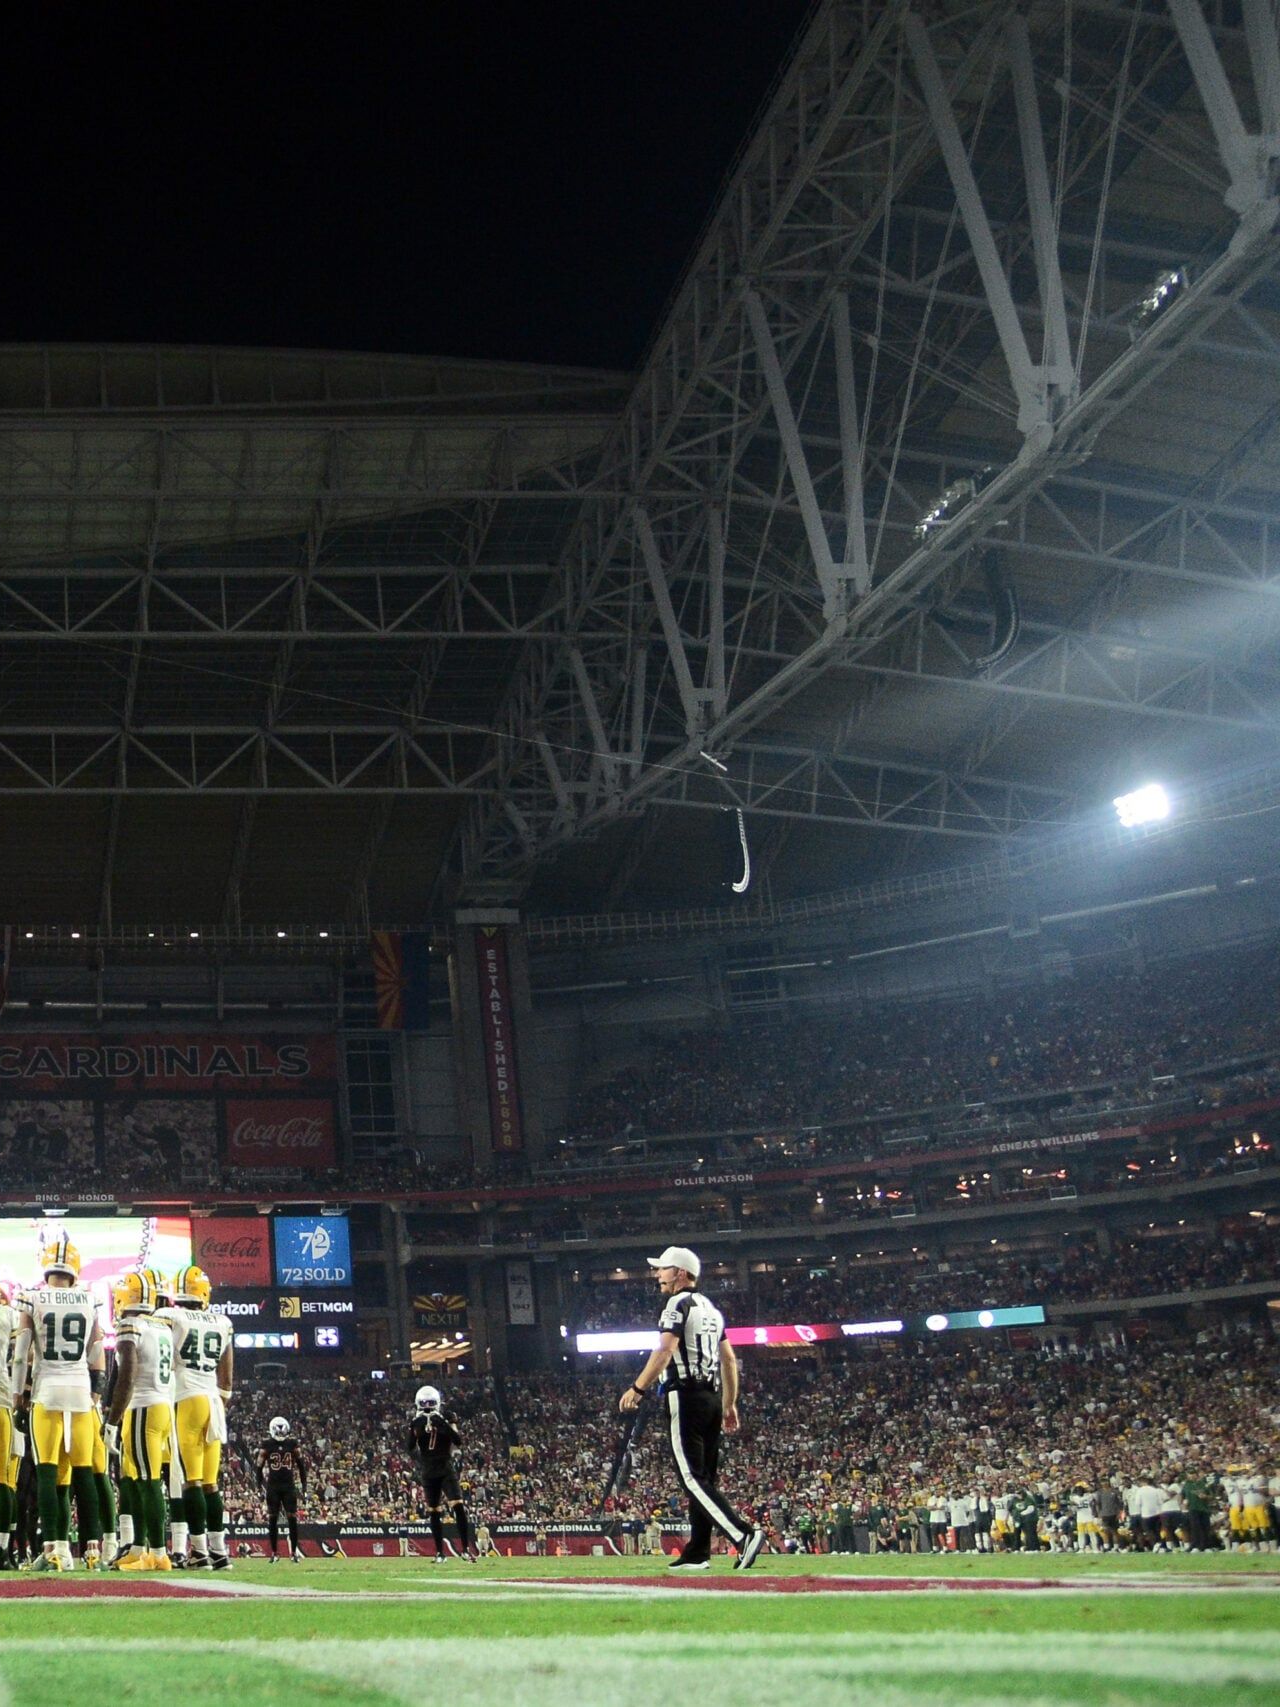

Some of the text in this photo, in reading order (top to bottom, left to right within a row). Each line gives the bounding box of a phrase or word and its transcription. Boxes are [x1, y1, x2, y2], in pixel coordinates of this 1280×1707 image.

[486, 949, 508, 1091] ESTABLISHED
[233, 1117, 326, 1147] Coca-Cola
[992, 1131, 1099, 1153] AENEAS WILLIAMS
[674, 1173, 753, 1186] OLLIE MATSON
[35, 1194, 61, 1202] RING
[78, 1194, 115, 1202] HONOR
[201, 1236, 263, 1258] Coca-Cola
[55, 1292, 88, 1304] BROWN
[301, 1302, 353, 1312] BETMGM
[42, 1311, 87, 1361] 19
[317, 1328, 338, 1346] 25
[179, 1327, 222, 1372] 49
[270, 1452, 292, 1471] 34
[339, 1526, 384, 1534] ARIZONA
[545, 1523, 602, 1532] CARDINALS
